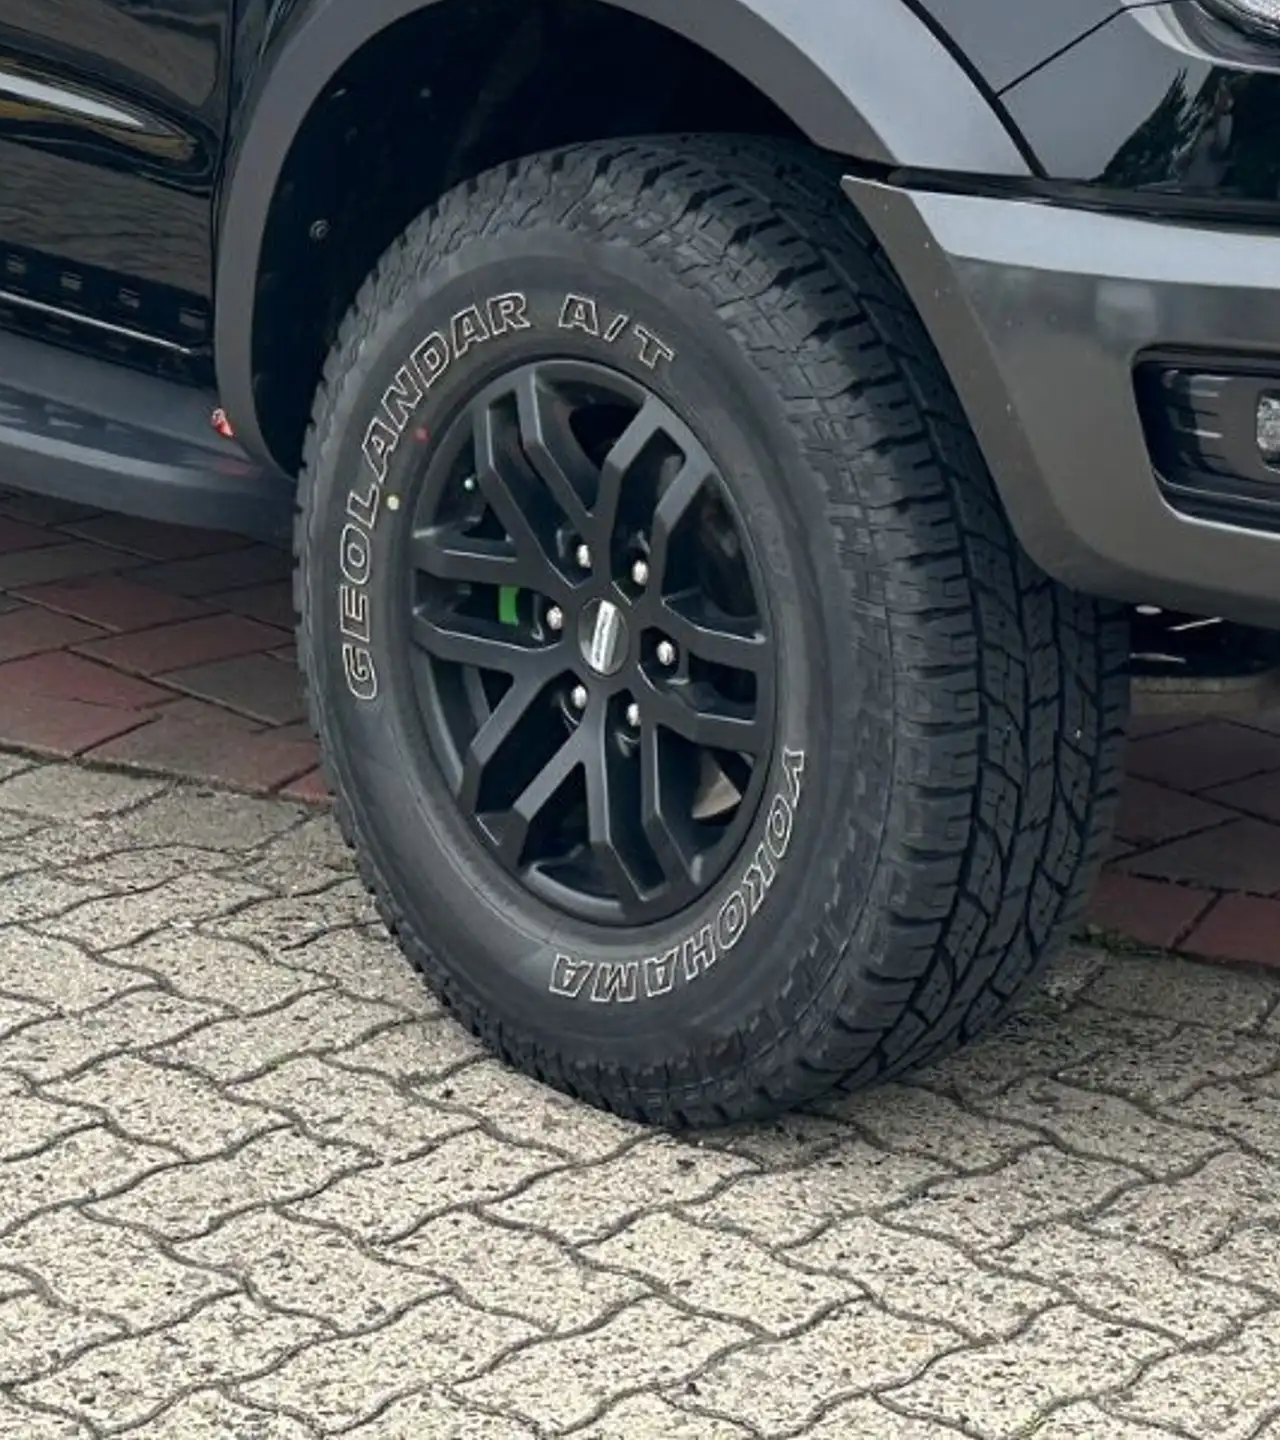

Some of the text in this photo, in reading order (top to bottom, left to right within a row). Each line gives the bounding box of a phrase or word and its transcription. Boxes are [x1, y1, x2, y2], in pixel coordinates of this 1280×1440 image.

[339, 292, 677, 699] GEOLANDAR A/T
[550, 748, 805, 1004] YOKOHAMA
